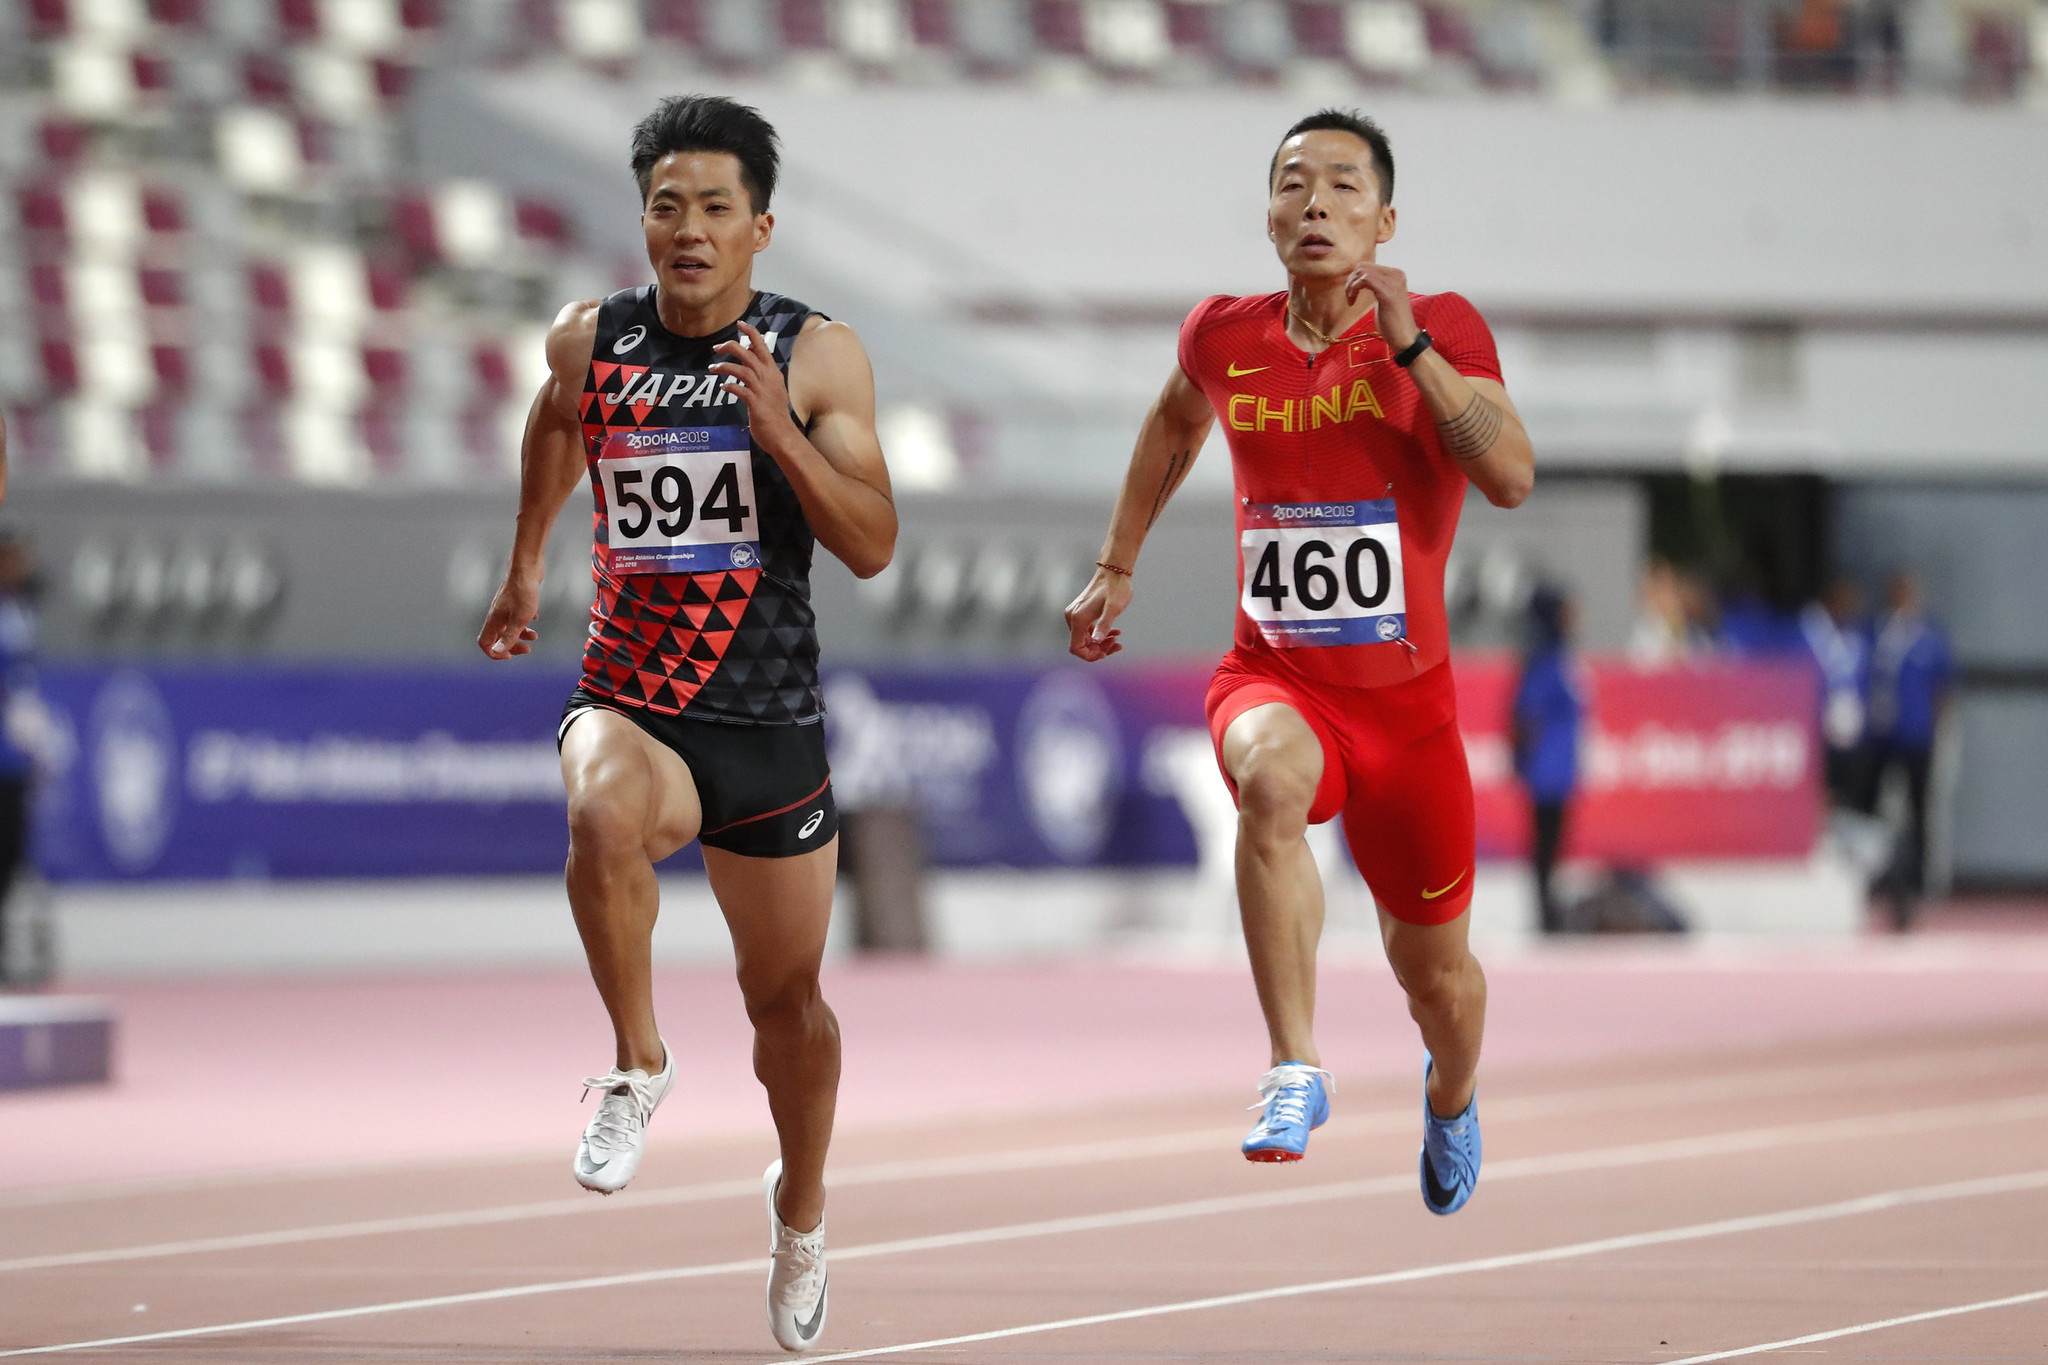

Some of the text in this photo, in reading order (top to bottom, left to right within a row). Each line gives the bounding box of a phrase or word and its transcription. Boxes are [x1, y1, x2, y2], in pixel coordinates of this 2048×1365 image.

[605, 371, 746, 408] JAPAN
[1229, 379, 1385, 432] CHINA
[613, 462, 750, 539] 594
[1251, 537, 1391, 612] 460
